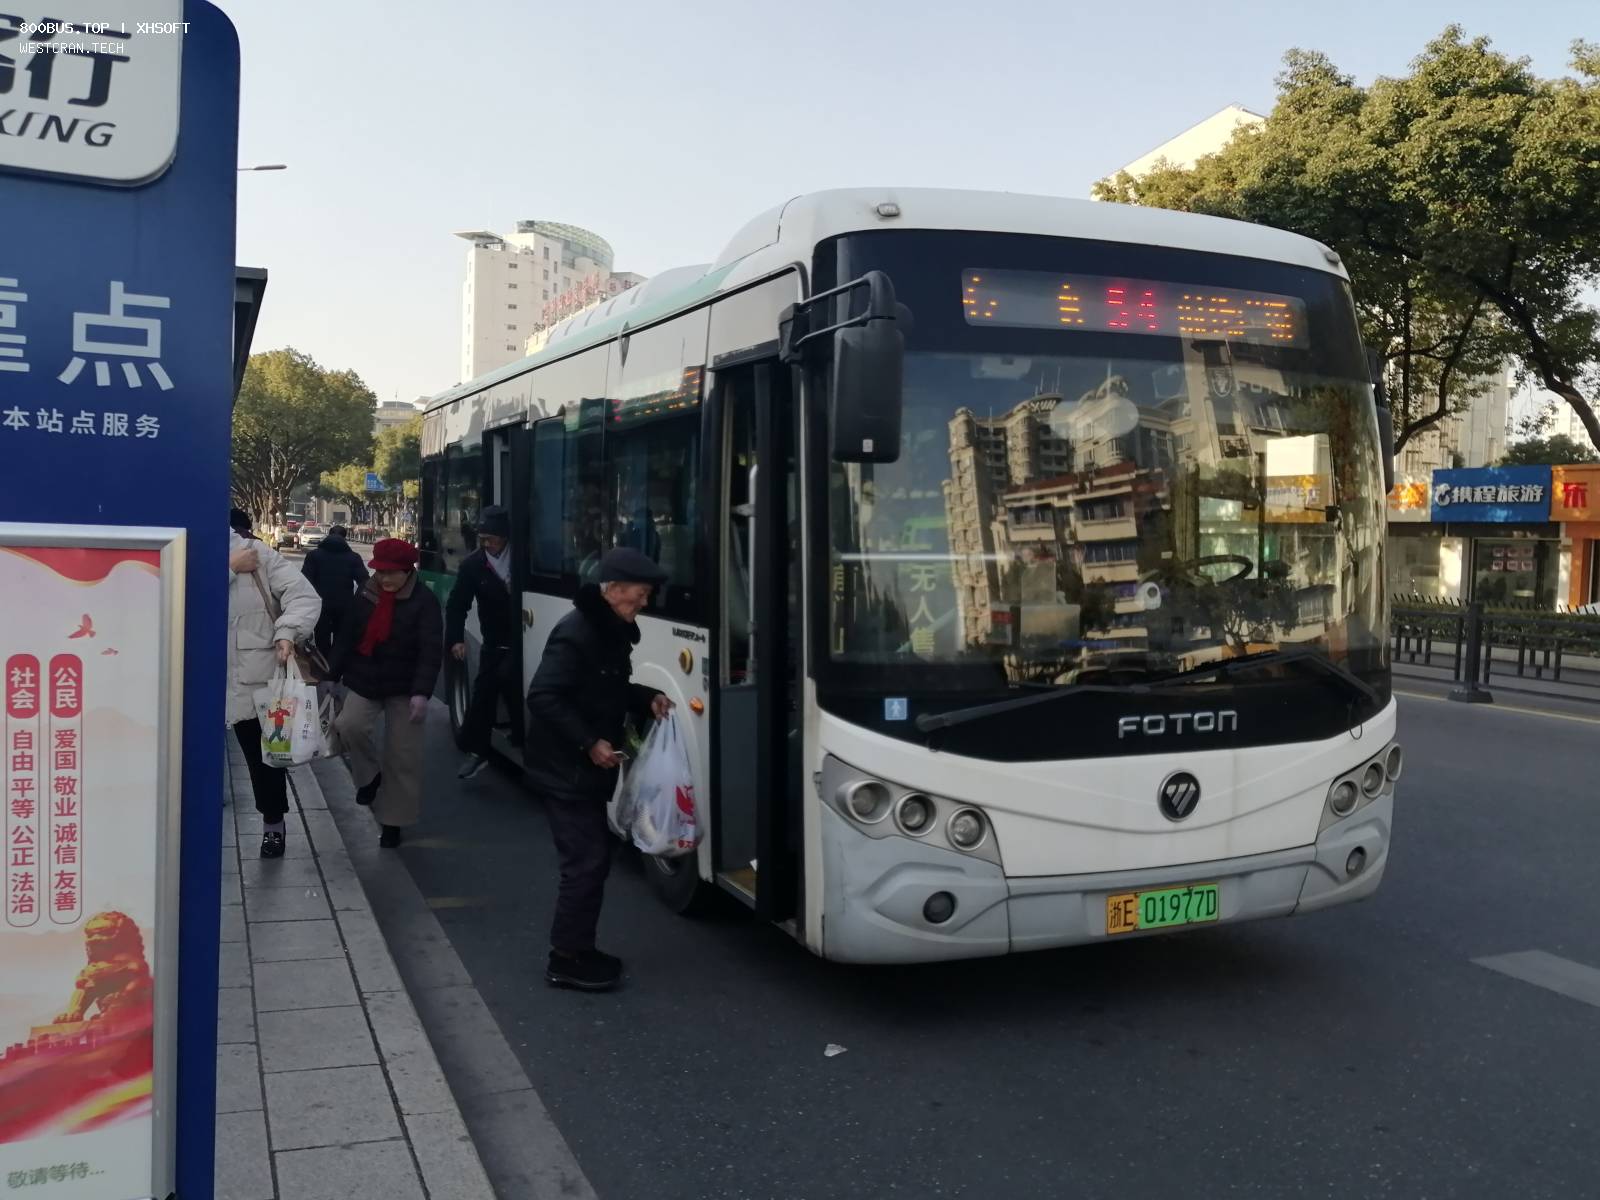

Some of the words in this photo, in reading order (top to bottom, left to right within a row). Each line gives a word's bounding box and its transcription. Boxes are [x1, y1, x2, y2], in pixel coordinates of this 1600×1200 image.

[0, 13, 132, 108] 行
[2, 405, 161, 439] 本站点服务
[1451, 484, 1544, 504] 携程旅游
[10, 667, 35, 710] 社会
[54, 667, 78, 709] 公民
[1118, 710, 1238, 739] FOTON
[12, 730, 34, 772] 自由
[54, 729, 77, 770] 爱国
[11, 778, 35, 819] 平等
[54, 776, 77, 817] 敬业
[11, 825, 35, 867] 公正
[54, 823, 77, 864] 诚信
[11, 872, 35, 914] 法治
[54, 870, 77, 911] 友善
